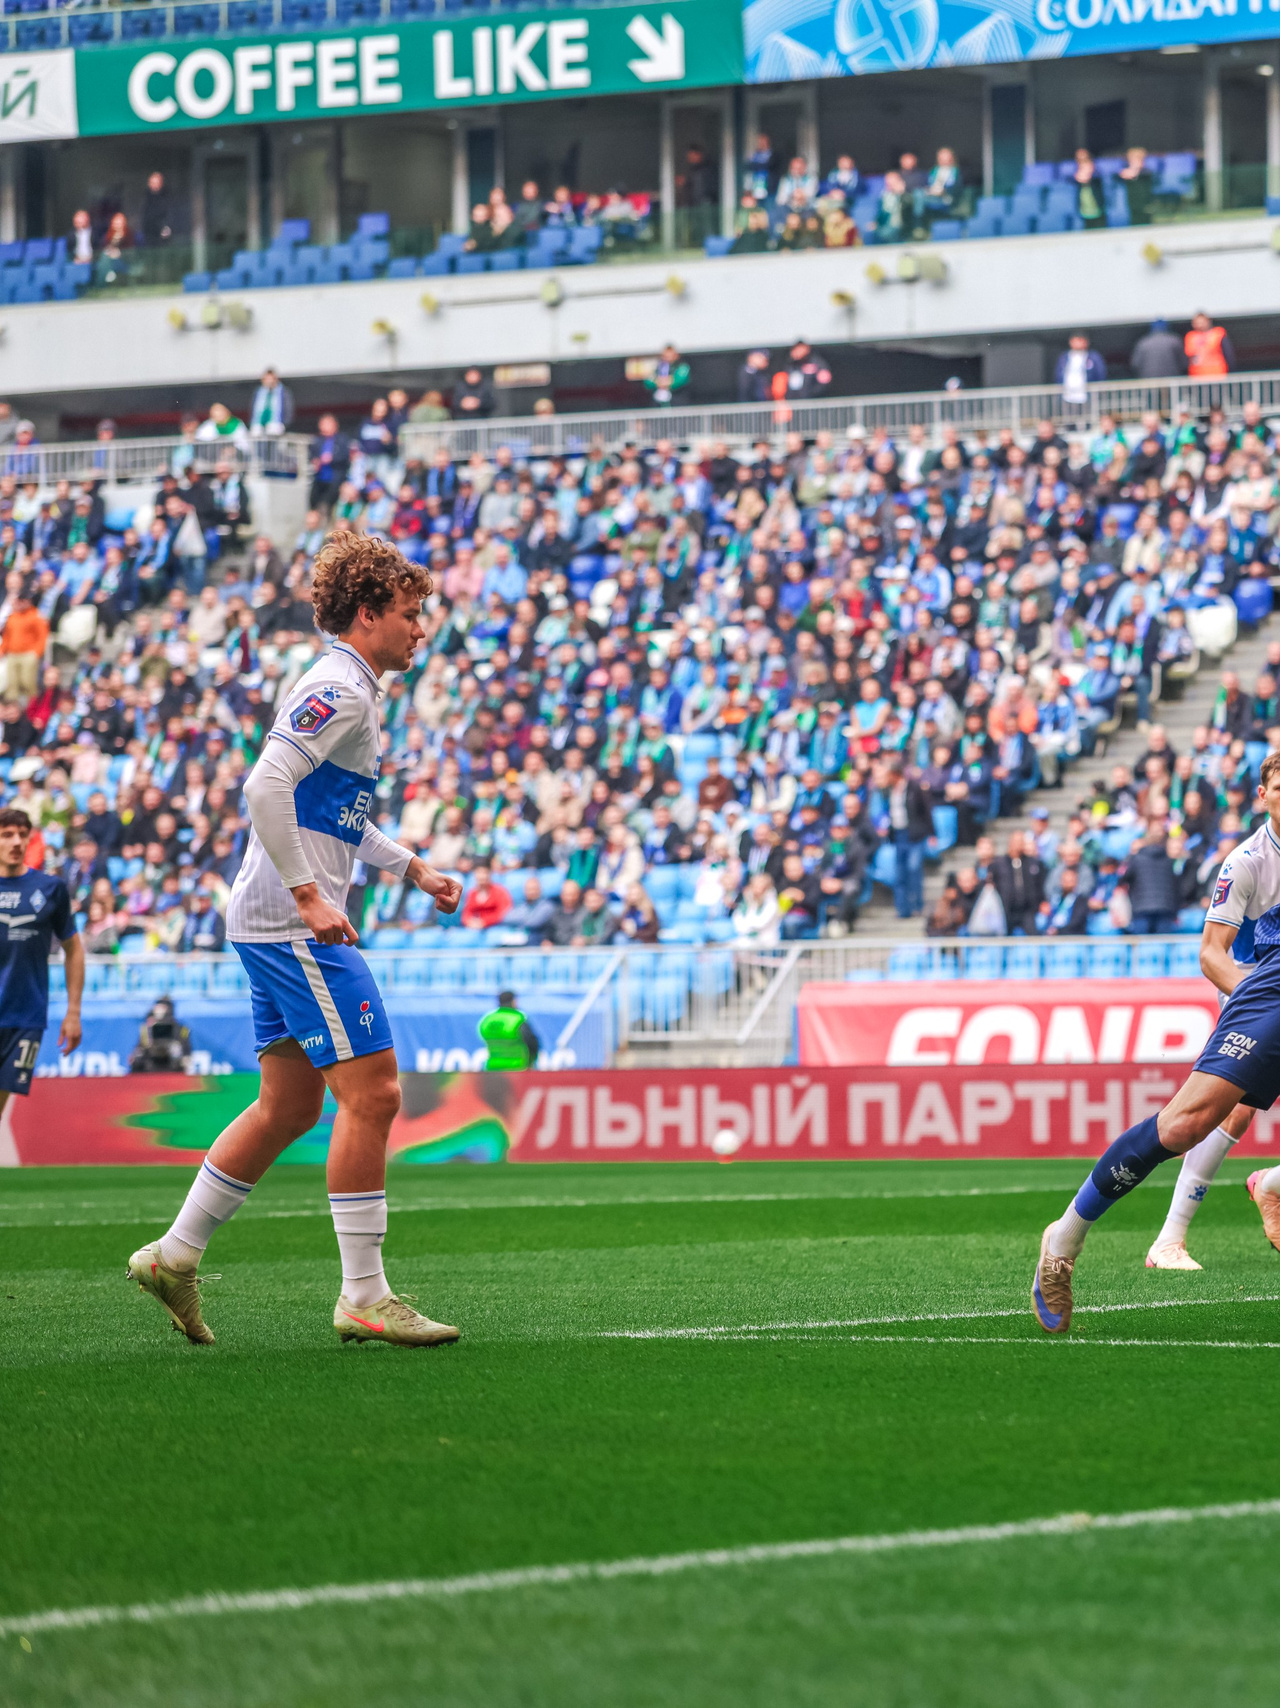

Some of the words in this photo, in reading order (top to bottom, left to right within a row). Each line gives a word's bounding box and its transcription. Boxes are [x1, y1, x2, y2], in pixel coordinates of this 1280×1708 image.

[127, 34, 402, 122] COFFEE
[433, 18, 591, 99] LIKE
[13, 1039, 40, 1069] 10
[1217, 1042, 1251, 1060] BET
[1223, 1031, 1258, 1050] FON
[848, 1068, 1178, 1145] ПАРТНЁ
